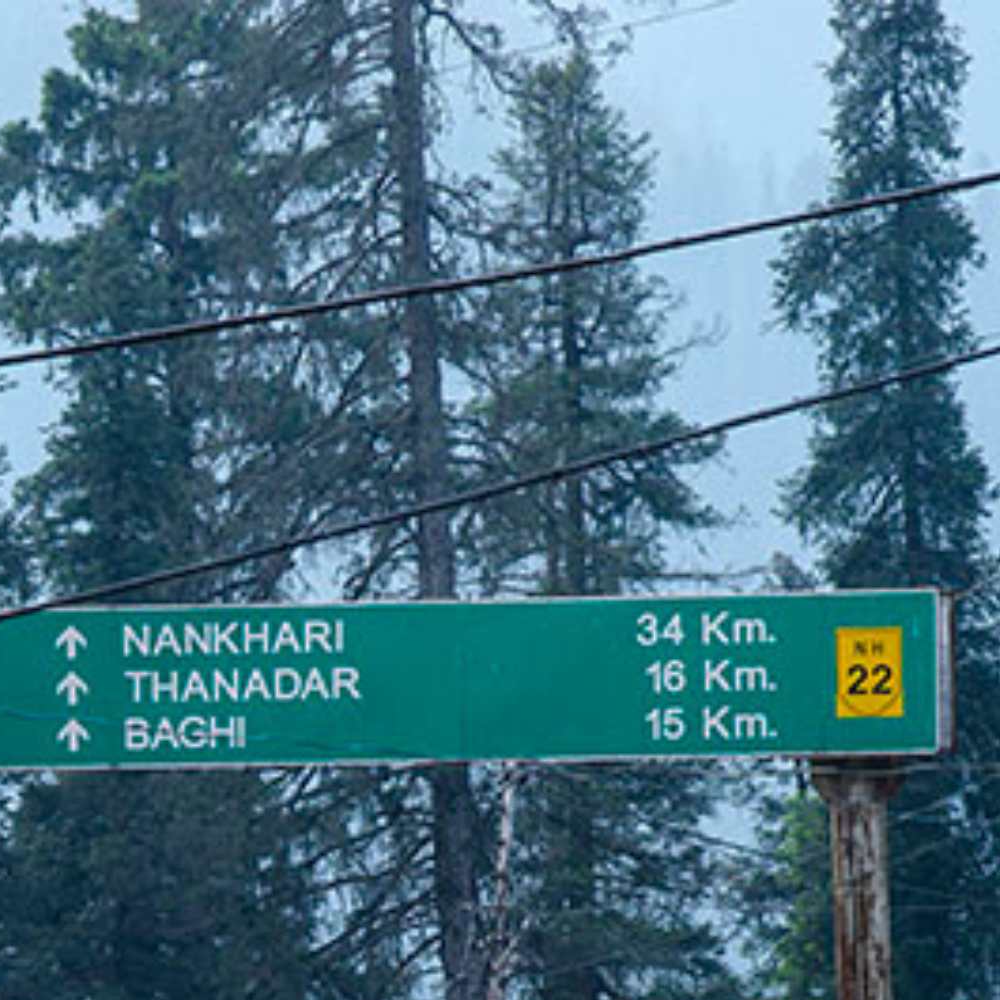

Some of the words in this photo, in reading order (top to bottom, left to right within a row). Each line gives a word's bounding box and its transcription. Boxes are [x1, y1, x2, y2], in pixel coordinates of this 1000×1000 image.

[122, 619, 345, 657] NANKHARI
[636, 613, 684, 645] 34
[700, 611, 776, 643] Km.
[125, 667, 361, 702] THANADAR
[646, 660, 686, 692] 16
[703, 660, 777, 692] Km.
[847, 663, 892, 696] 22
[124, 716, 247, 751] BAGHI
[646, 708, 685, 740] 15
[702, 706, 777, 738] Km.
